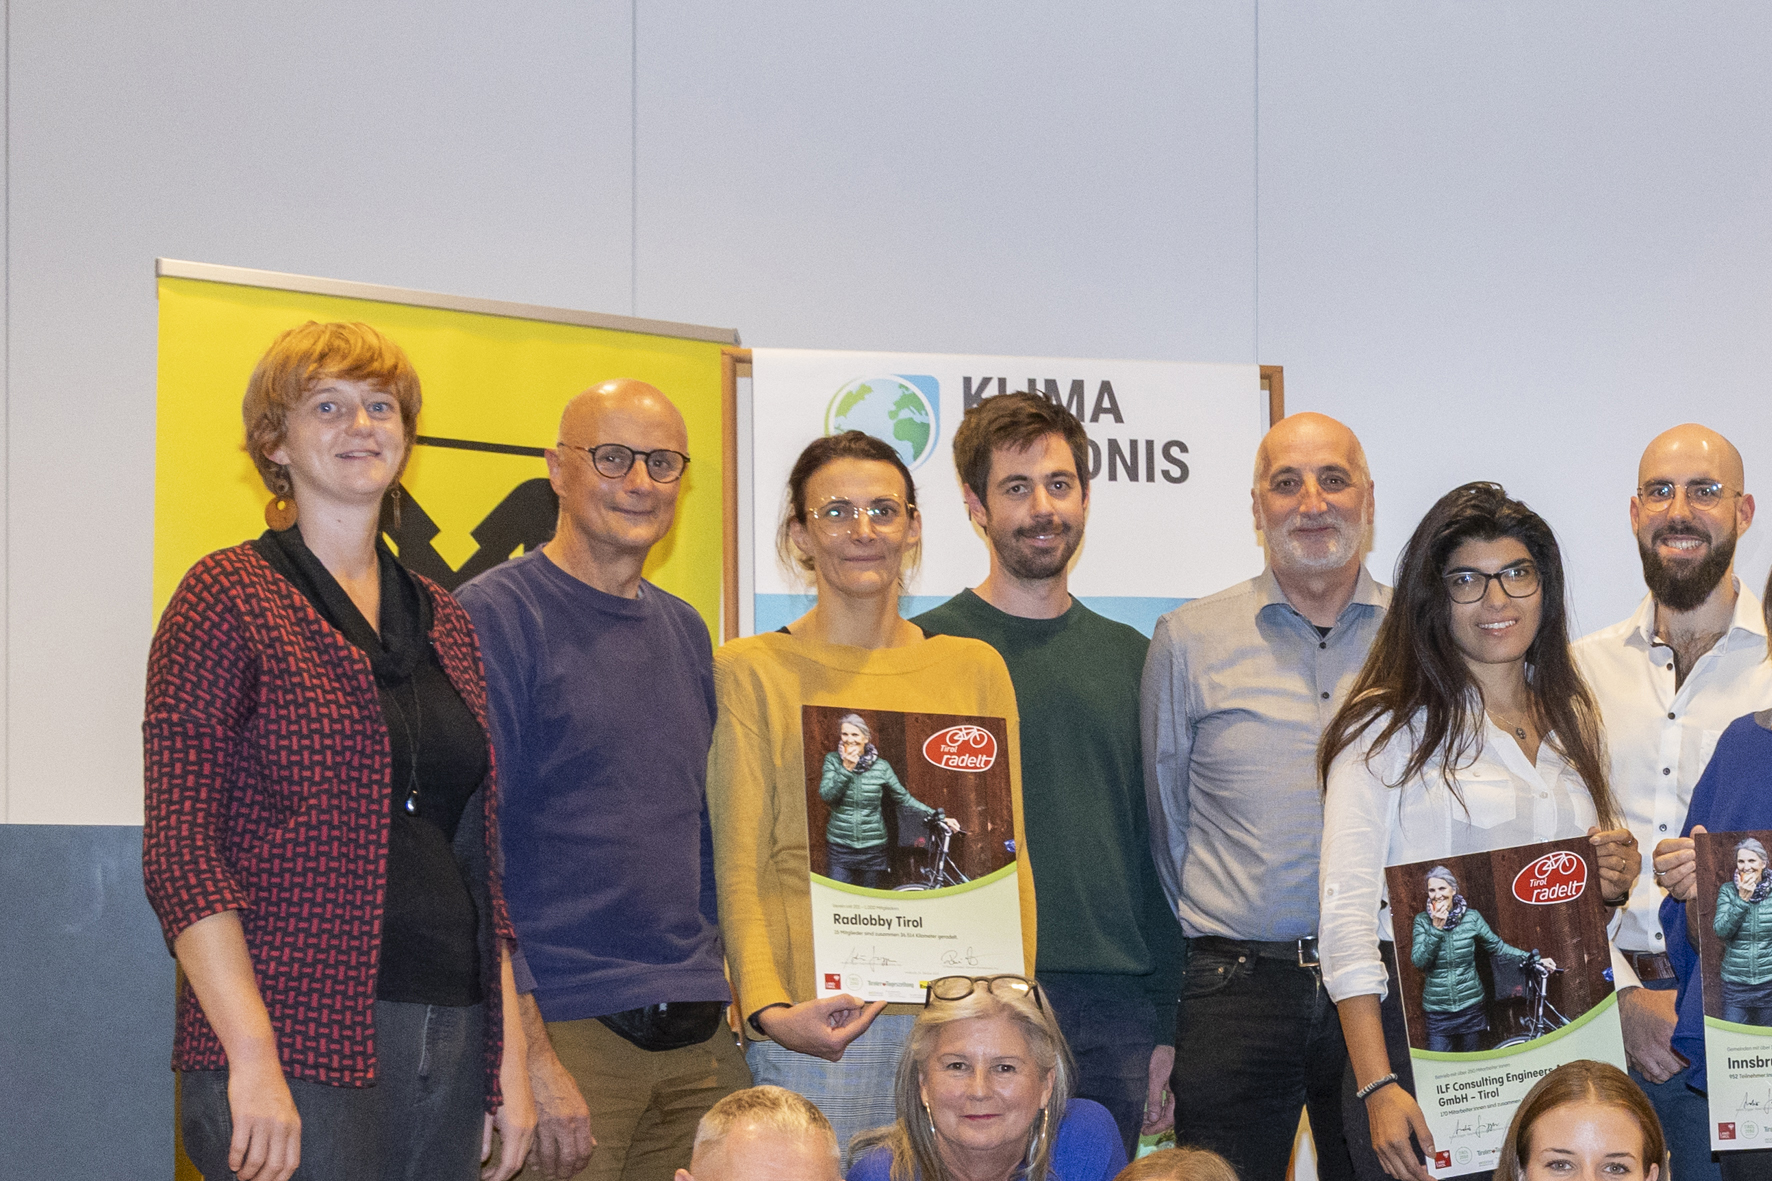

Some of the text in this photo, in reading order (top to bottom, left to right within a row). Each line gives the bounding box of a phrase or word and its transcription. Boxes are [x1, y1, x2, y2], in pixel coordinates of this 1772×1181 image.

[941, 745, 958, 753] Tirol
[942, 754, 987, 767] radelt
[1530, 877, 1547, 887] Tirol
[1532, 881, 1578, 902] radelt
[834, 913, 923, 930] Radlobby Tirol
[1436, 1084, 1451, 1095] ILF
[1453, 1075, 1505, 1091] Consulting
[1438, 1088, 1500, 1107] GmbH Tirol
